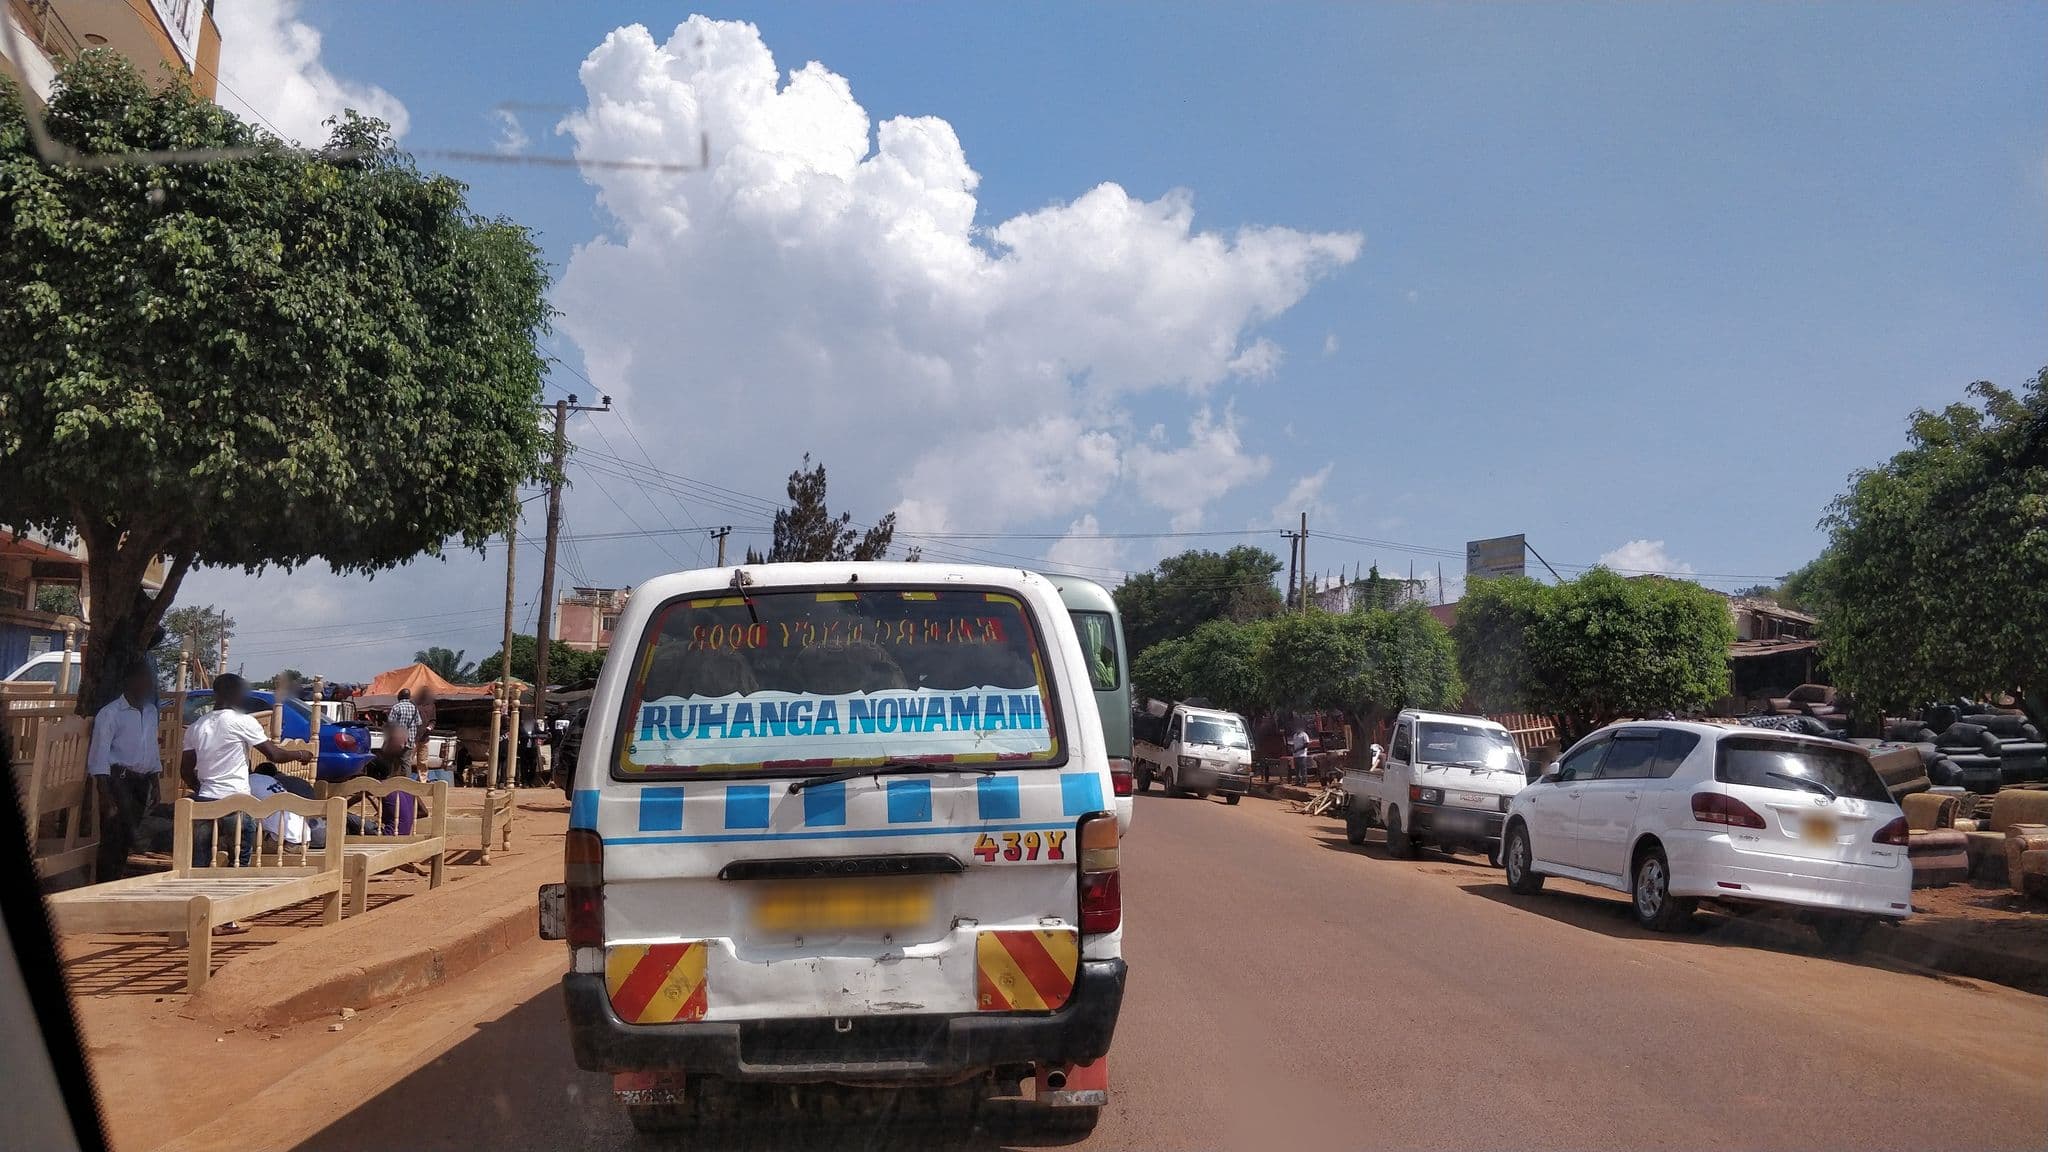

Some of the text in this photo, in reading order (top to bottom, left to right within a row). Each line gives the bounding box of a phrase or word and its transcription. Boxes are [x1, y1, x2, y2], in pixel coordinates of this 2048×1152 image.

[639, 693, 1042, 742] RUHANGA NOWAMANI
[973, 830, 1067, 862] 439Y
